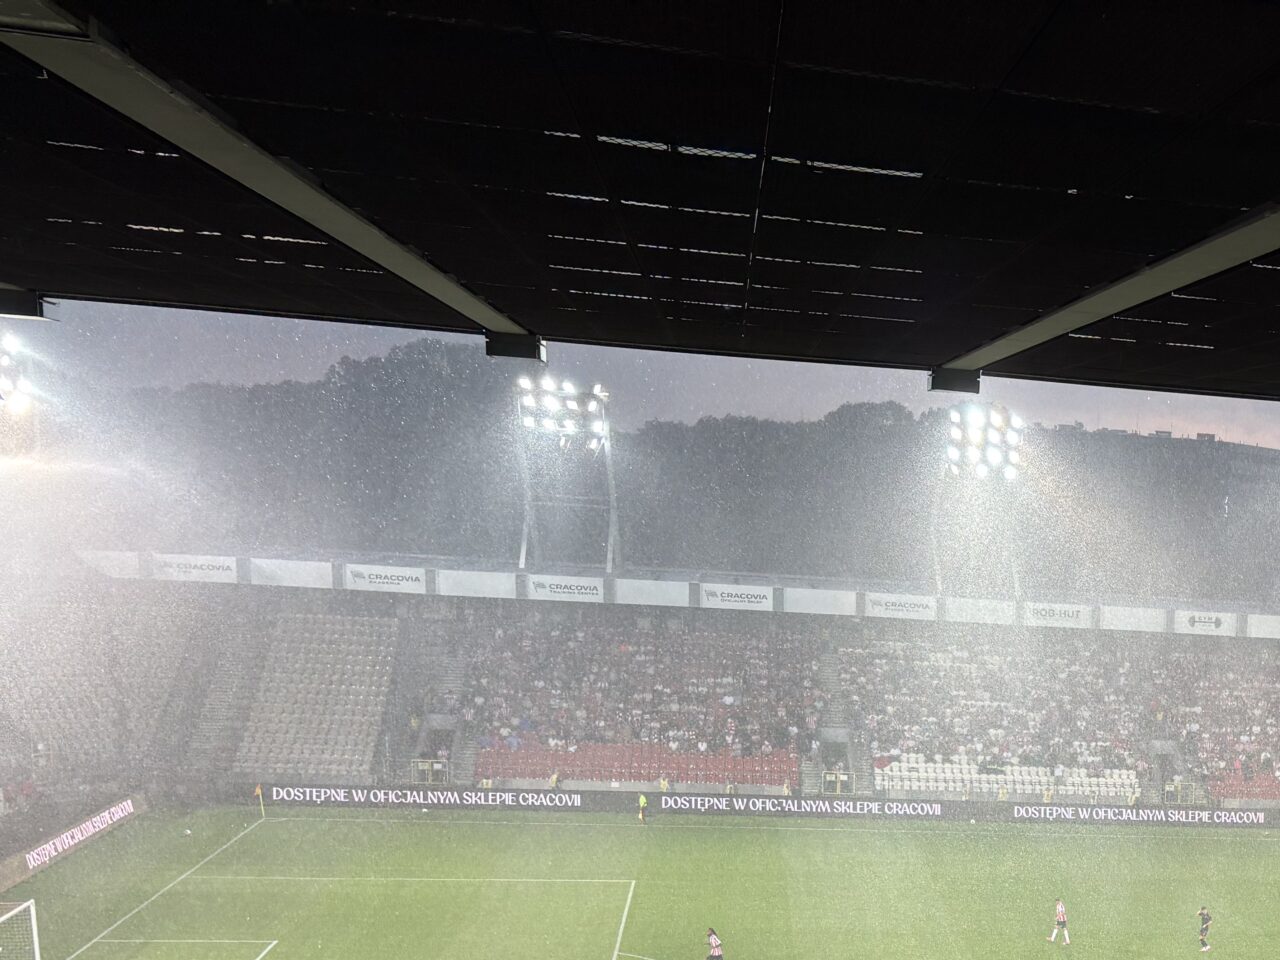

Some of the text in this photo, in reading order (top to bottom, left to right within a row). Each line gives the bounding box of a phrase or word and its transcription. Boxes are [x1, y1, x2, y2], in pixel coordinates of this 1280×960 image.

[368, 573, 421, 583] CRACOVIA
[548, 583, 599, 592] CRACOVIA
[720, 591, 768, 600] CRACOVIA
[884, 601, 930, 610] CRACOVIA
[1032, 608, 1081, 619] ROB-HUT
[272, 787, 581, 807] DOSTĘPNE W OFICJALNYM SKLEPIE CRACOVII
[661, 796, 941, 816] DOSTĘPNE W OFICJALNYM SKLEPIE CRACOVII
[1014, 806, 1264, 824] DOSTĘPNE W OFICJALNYM SKLEPIE CRACOVII
